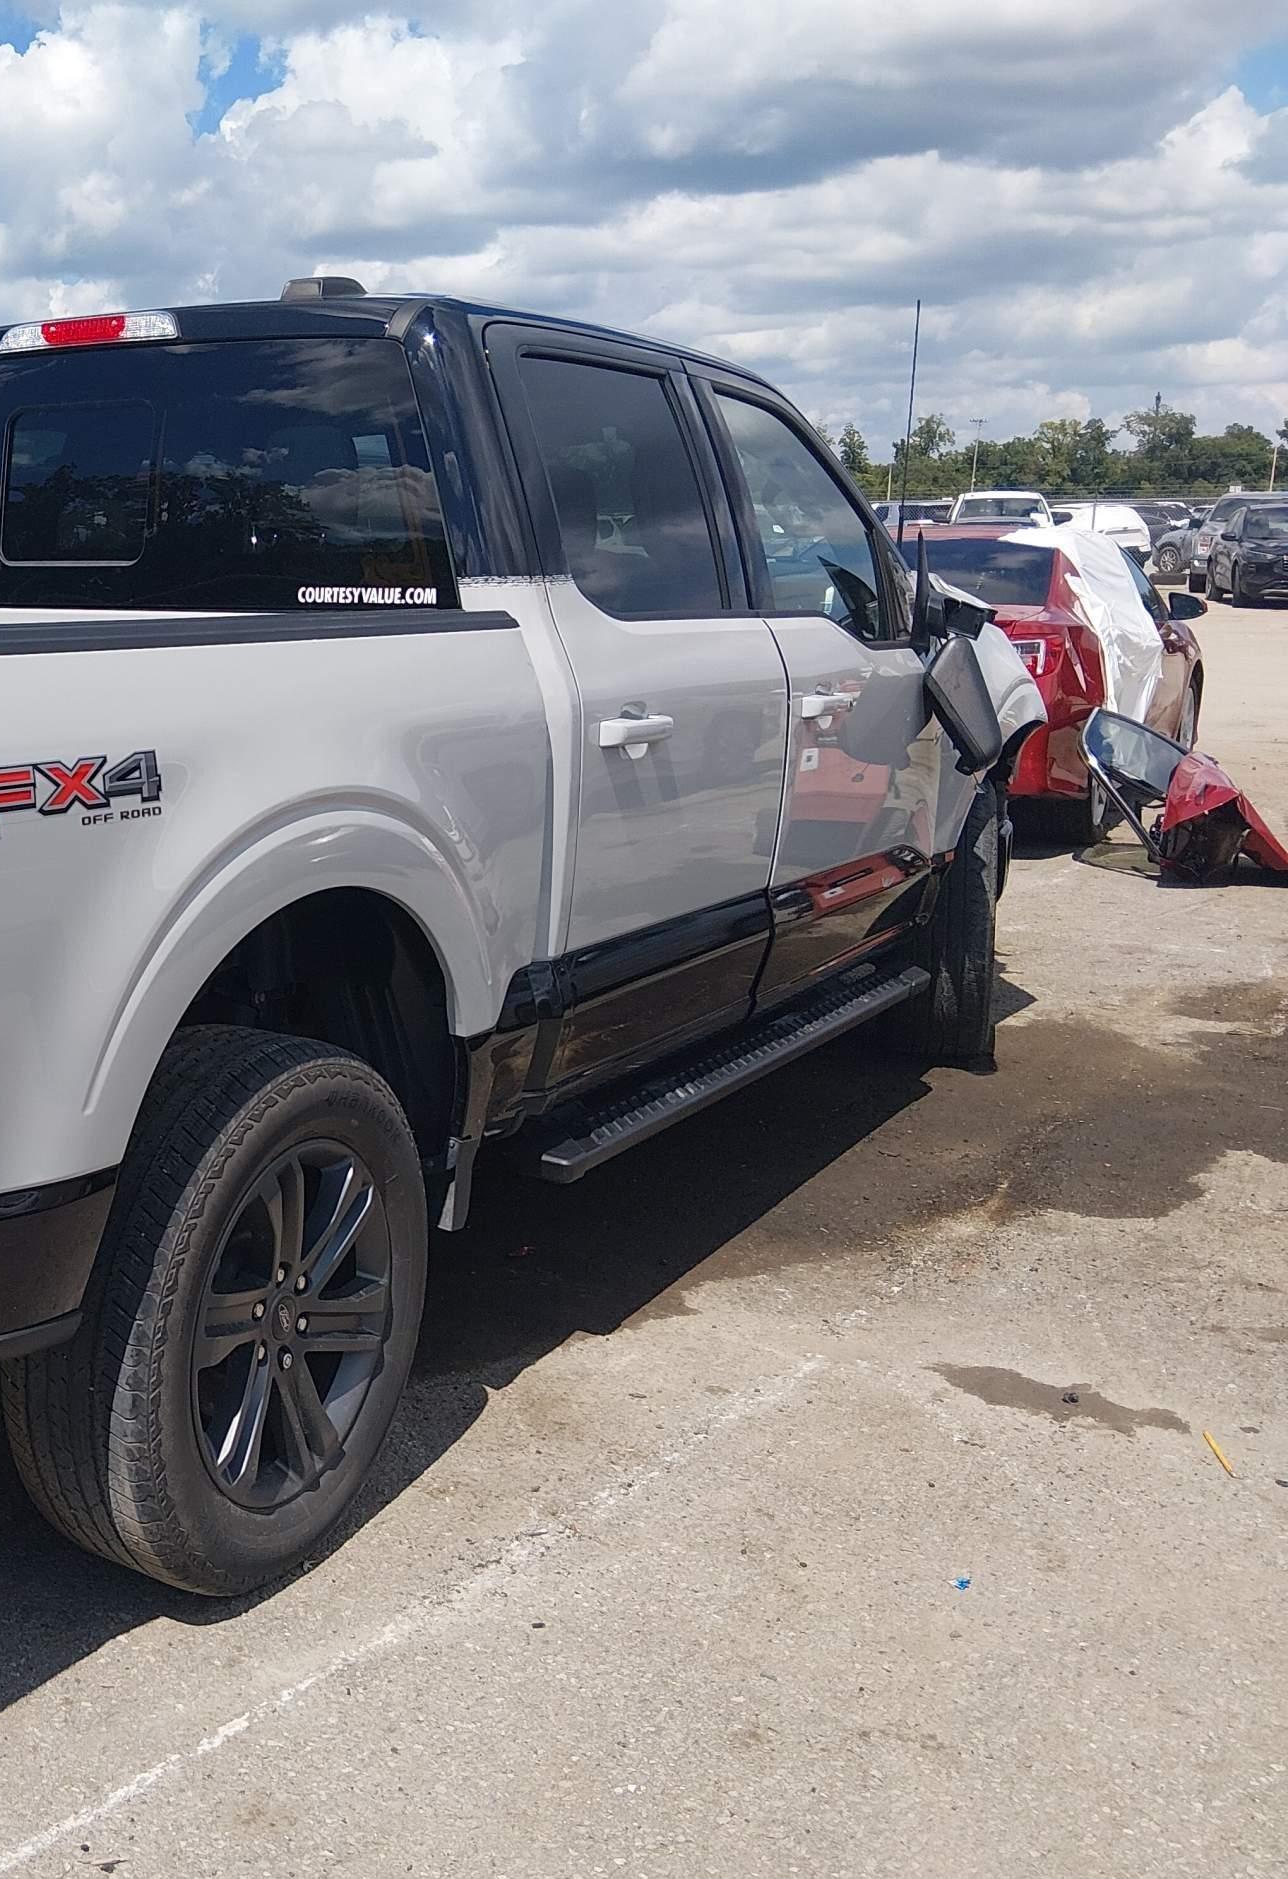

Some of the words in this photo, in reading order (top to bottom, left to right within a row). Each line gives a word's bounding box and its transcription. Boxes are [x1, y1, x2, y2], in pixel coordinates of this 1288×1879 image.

[297, 586, 437, 605] COURTESYVALUE.COM
[81, 813, 114, 827] OFF
[120, 806, 162, 821] ROAD
